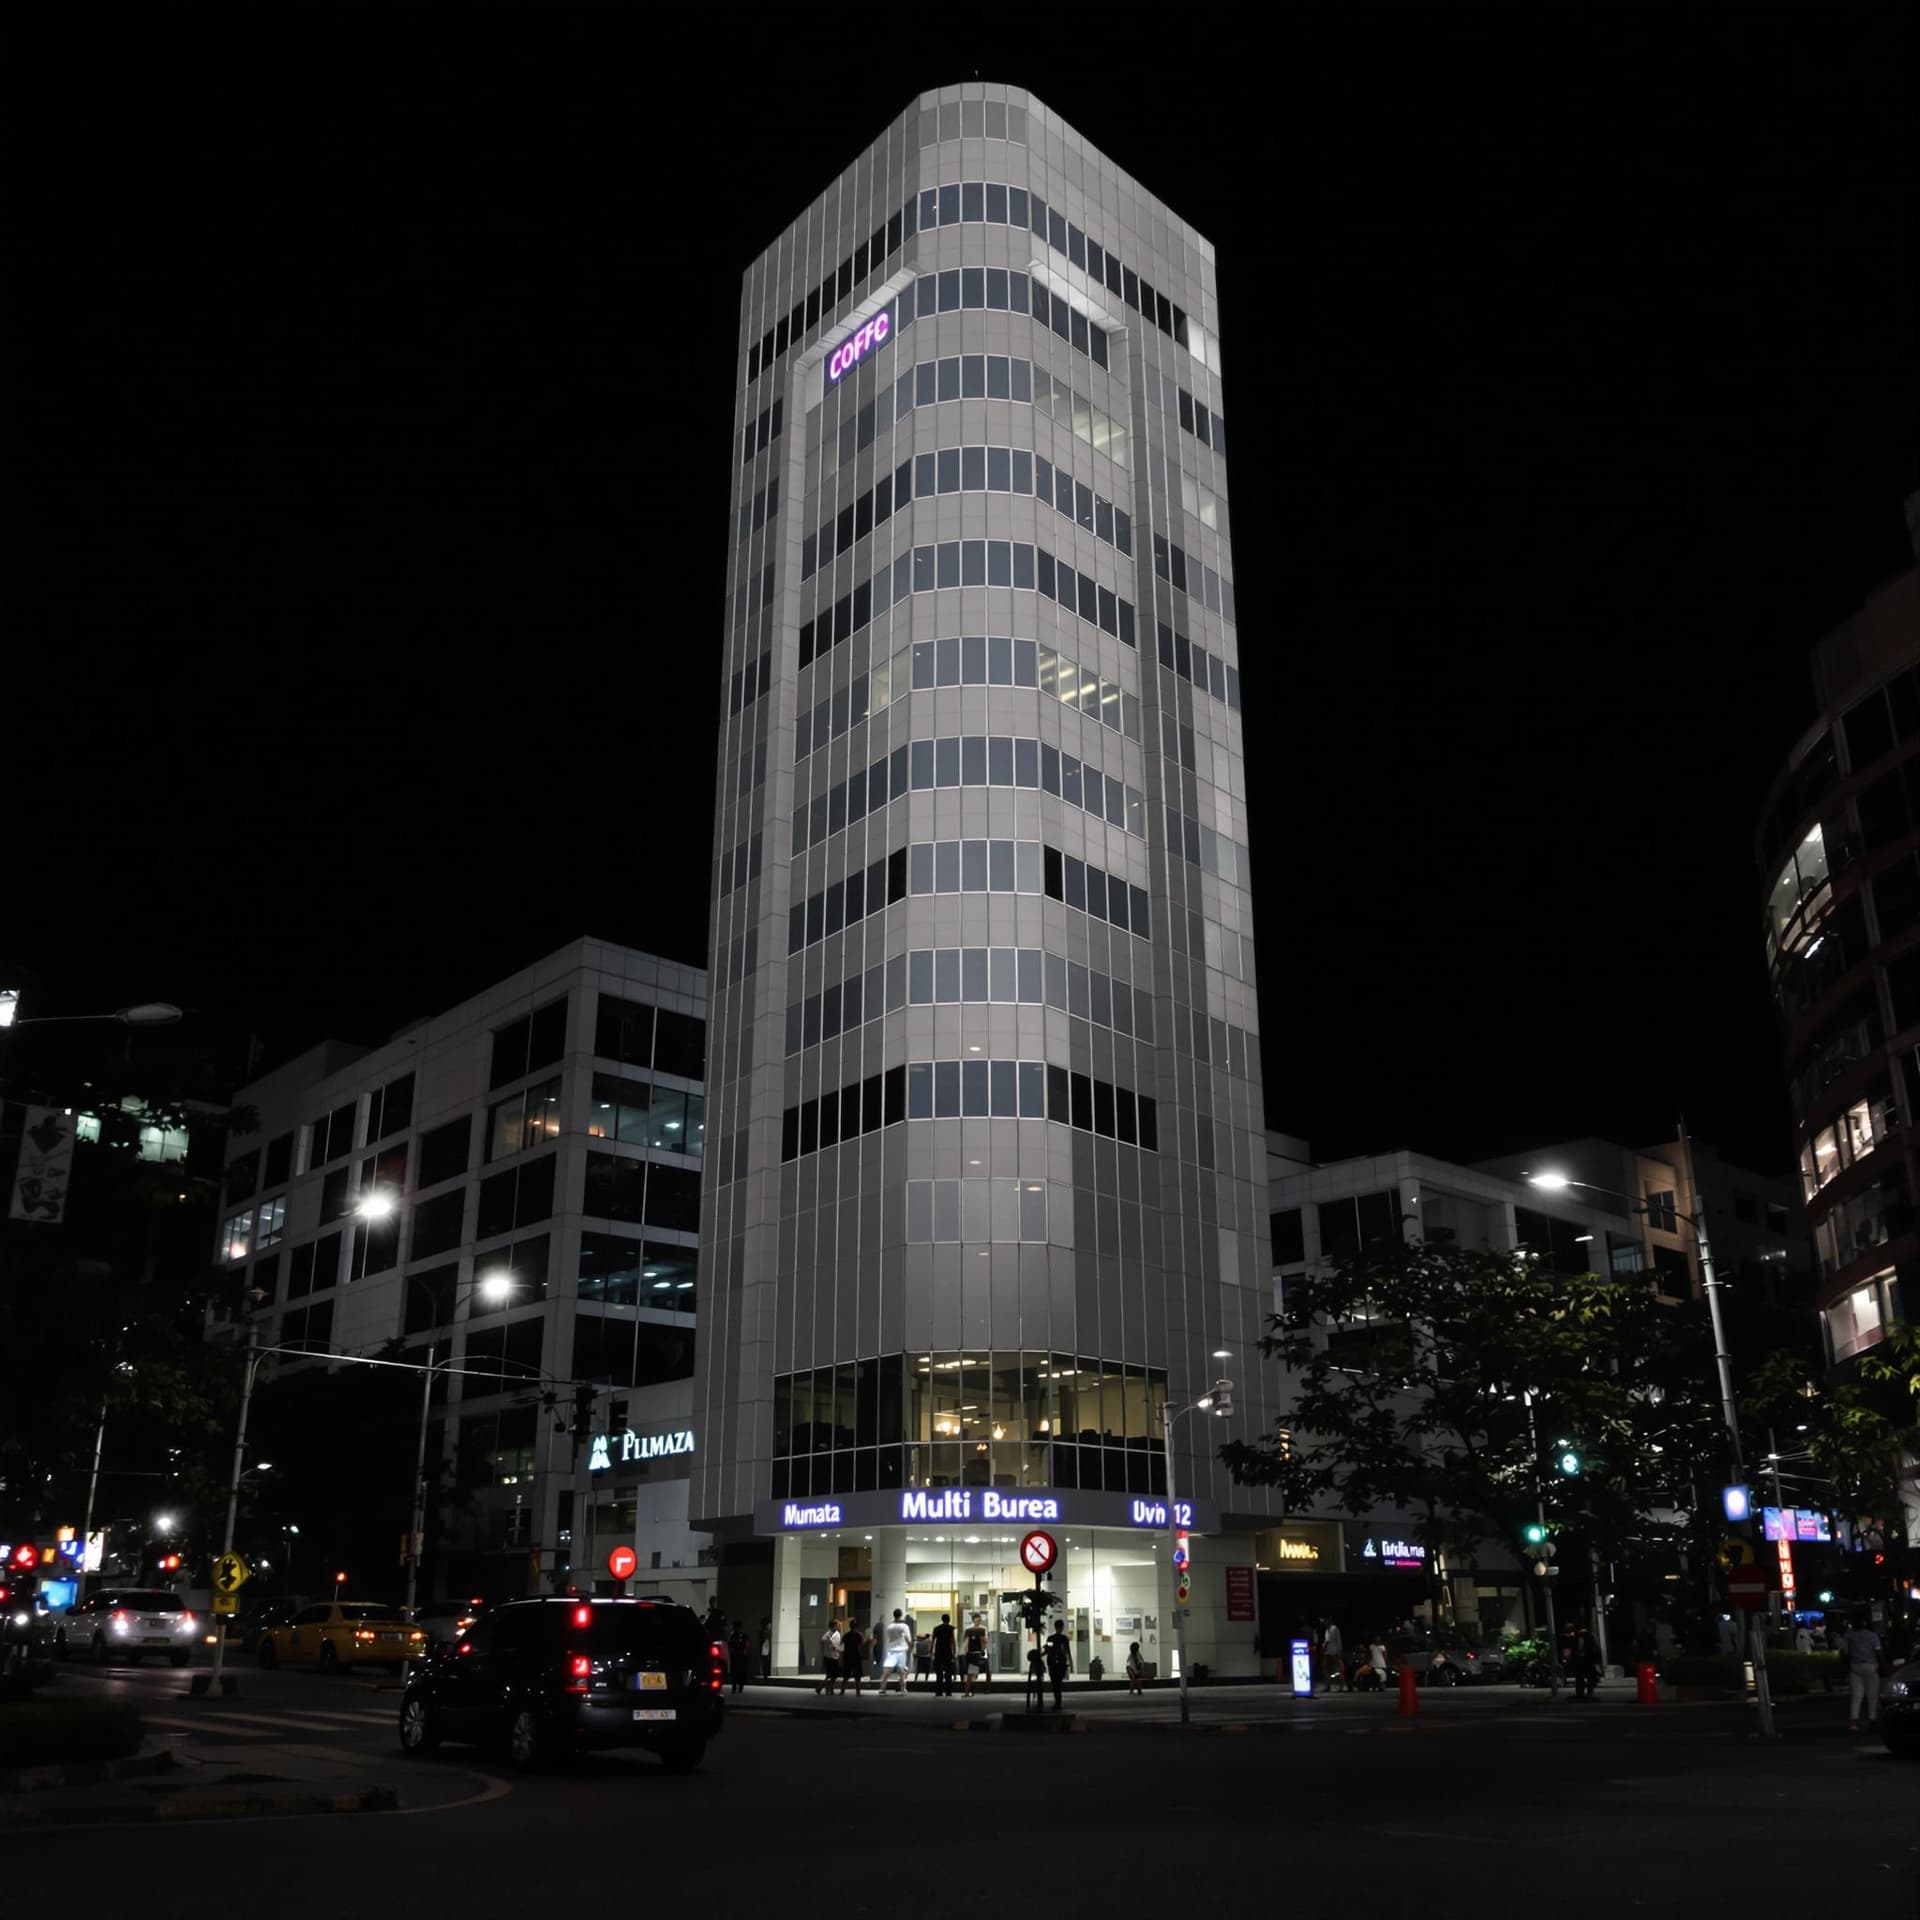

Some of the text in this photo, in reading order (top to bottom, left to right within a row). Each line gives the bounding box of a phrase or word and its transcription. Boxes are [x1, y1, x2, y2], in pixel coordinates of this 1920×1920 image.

[902, 1490, 1058, 1519] Multi Burea
[1173, 1503, 1192, 1526] 12
